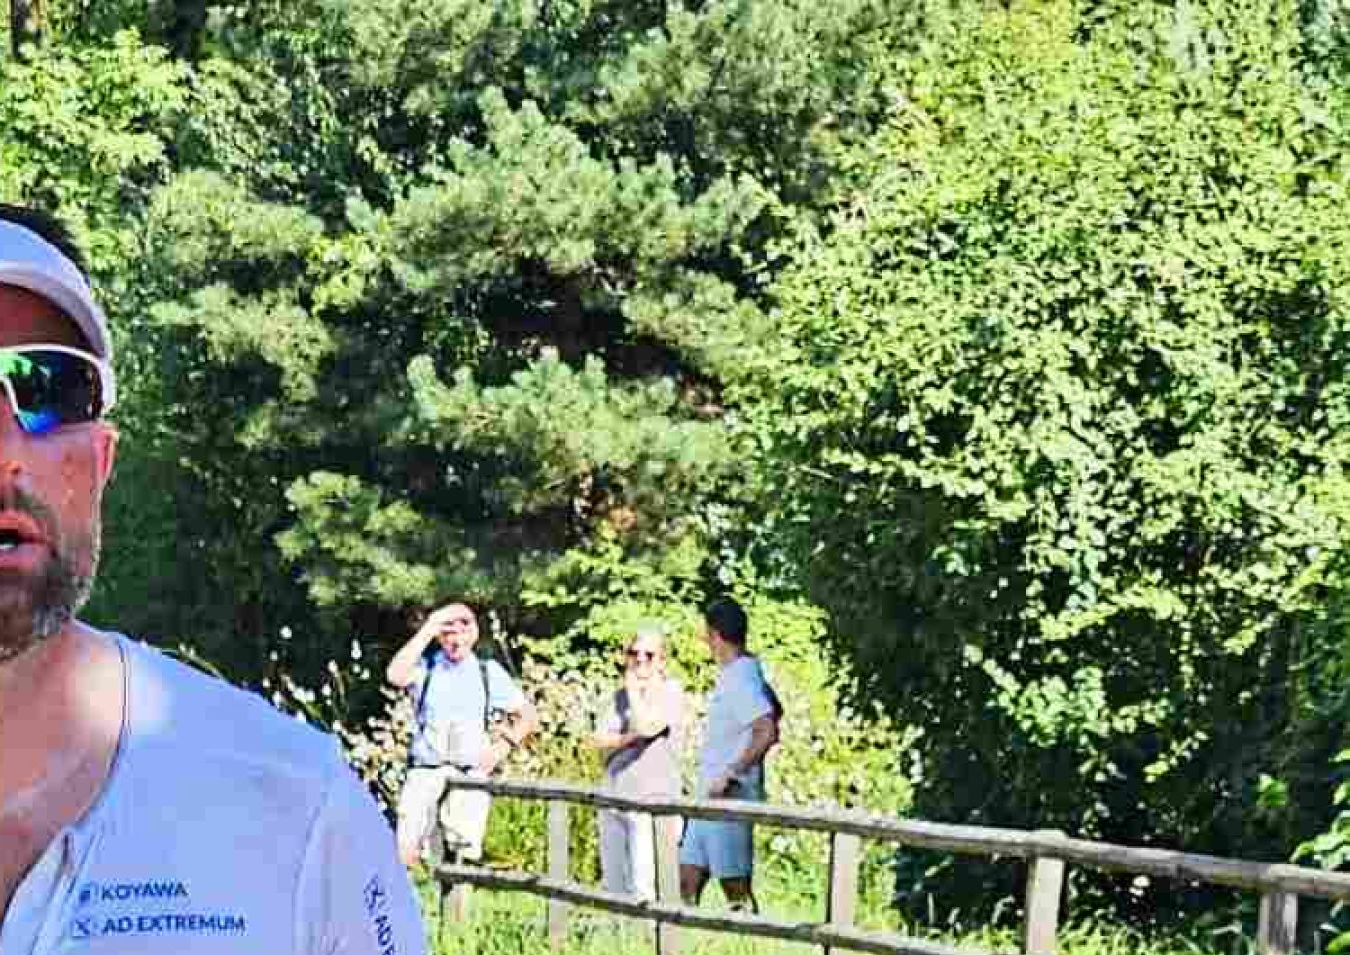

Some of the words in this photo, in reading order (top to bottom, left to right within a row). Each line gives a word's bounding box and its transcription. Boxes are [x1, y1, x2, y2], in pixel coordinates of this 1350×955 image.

[102, 881, 188, 901] KOYAWA
[103, 914, 133, 934] AD
[137, 912, 247, 933] EXTREMUM
